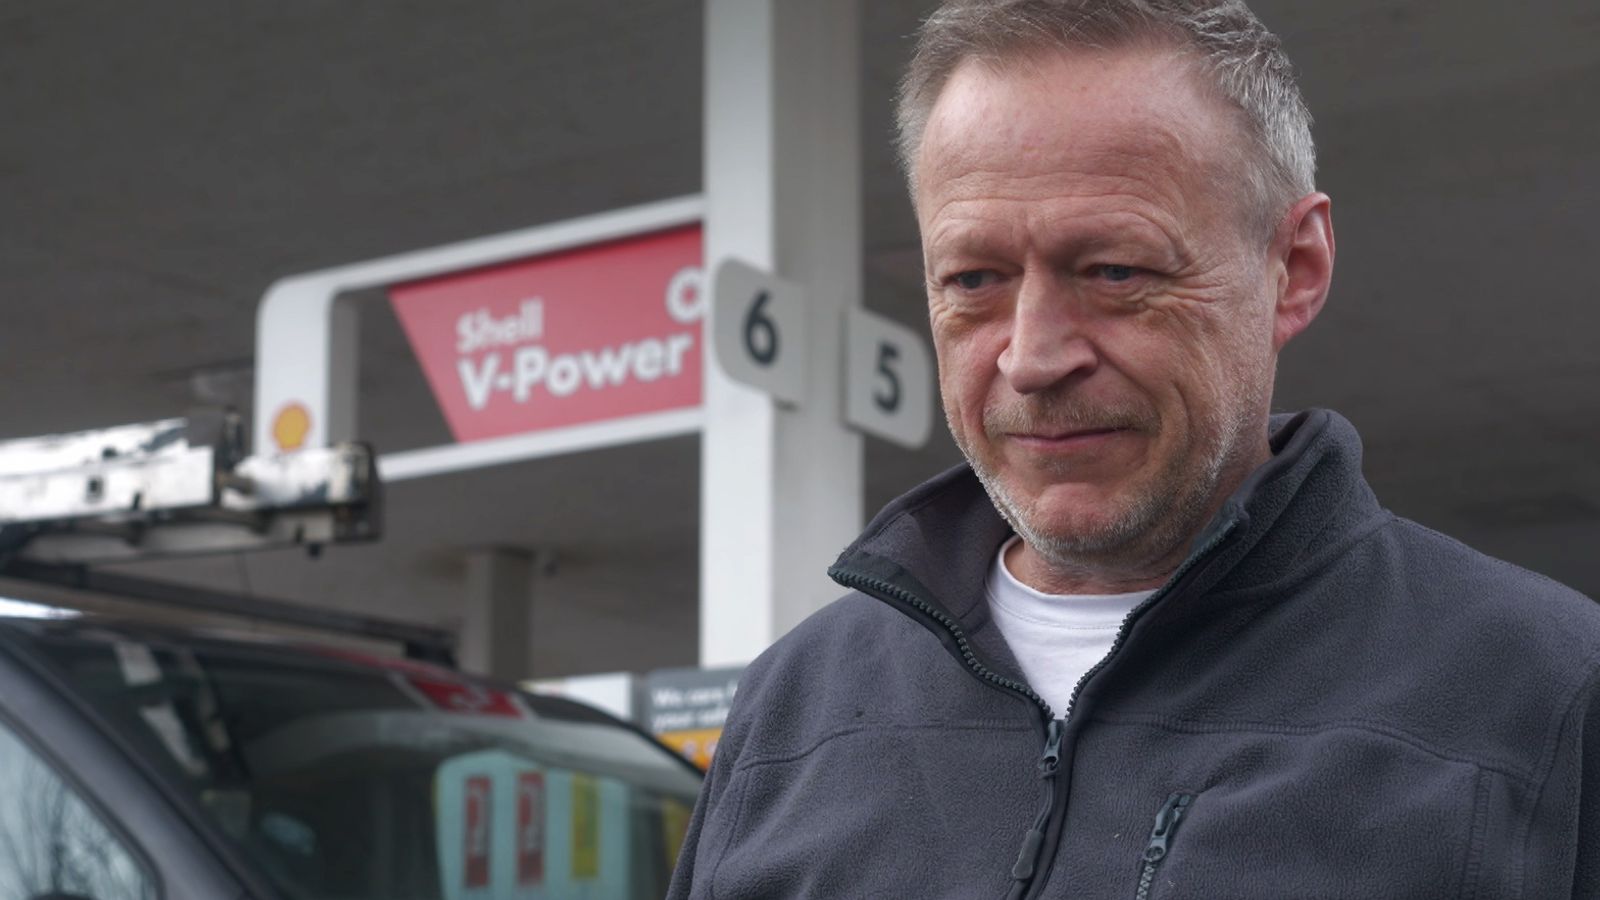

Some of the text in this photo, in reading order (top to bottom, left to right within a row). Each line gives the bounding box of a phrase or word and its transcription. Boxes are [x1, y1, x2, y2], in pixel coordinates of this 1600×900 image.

[456, 298, 544, 354] Shell
[744, 289, 781, 367] 6
[457, 333, 694, 412] V-Power
[873, 343, 904, 413] 5
